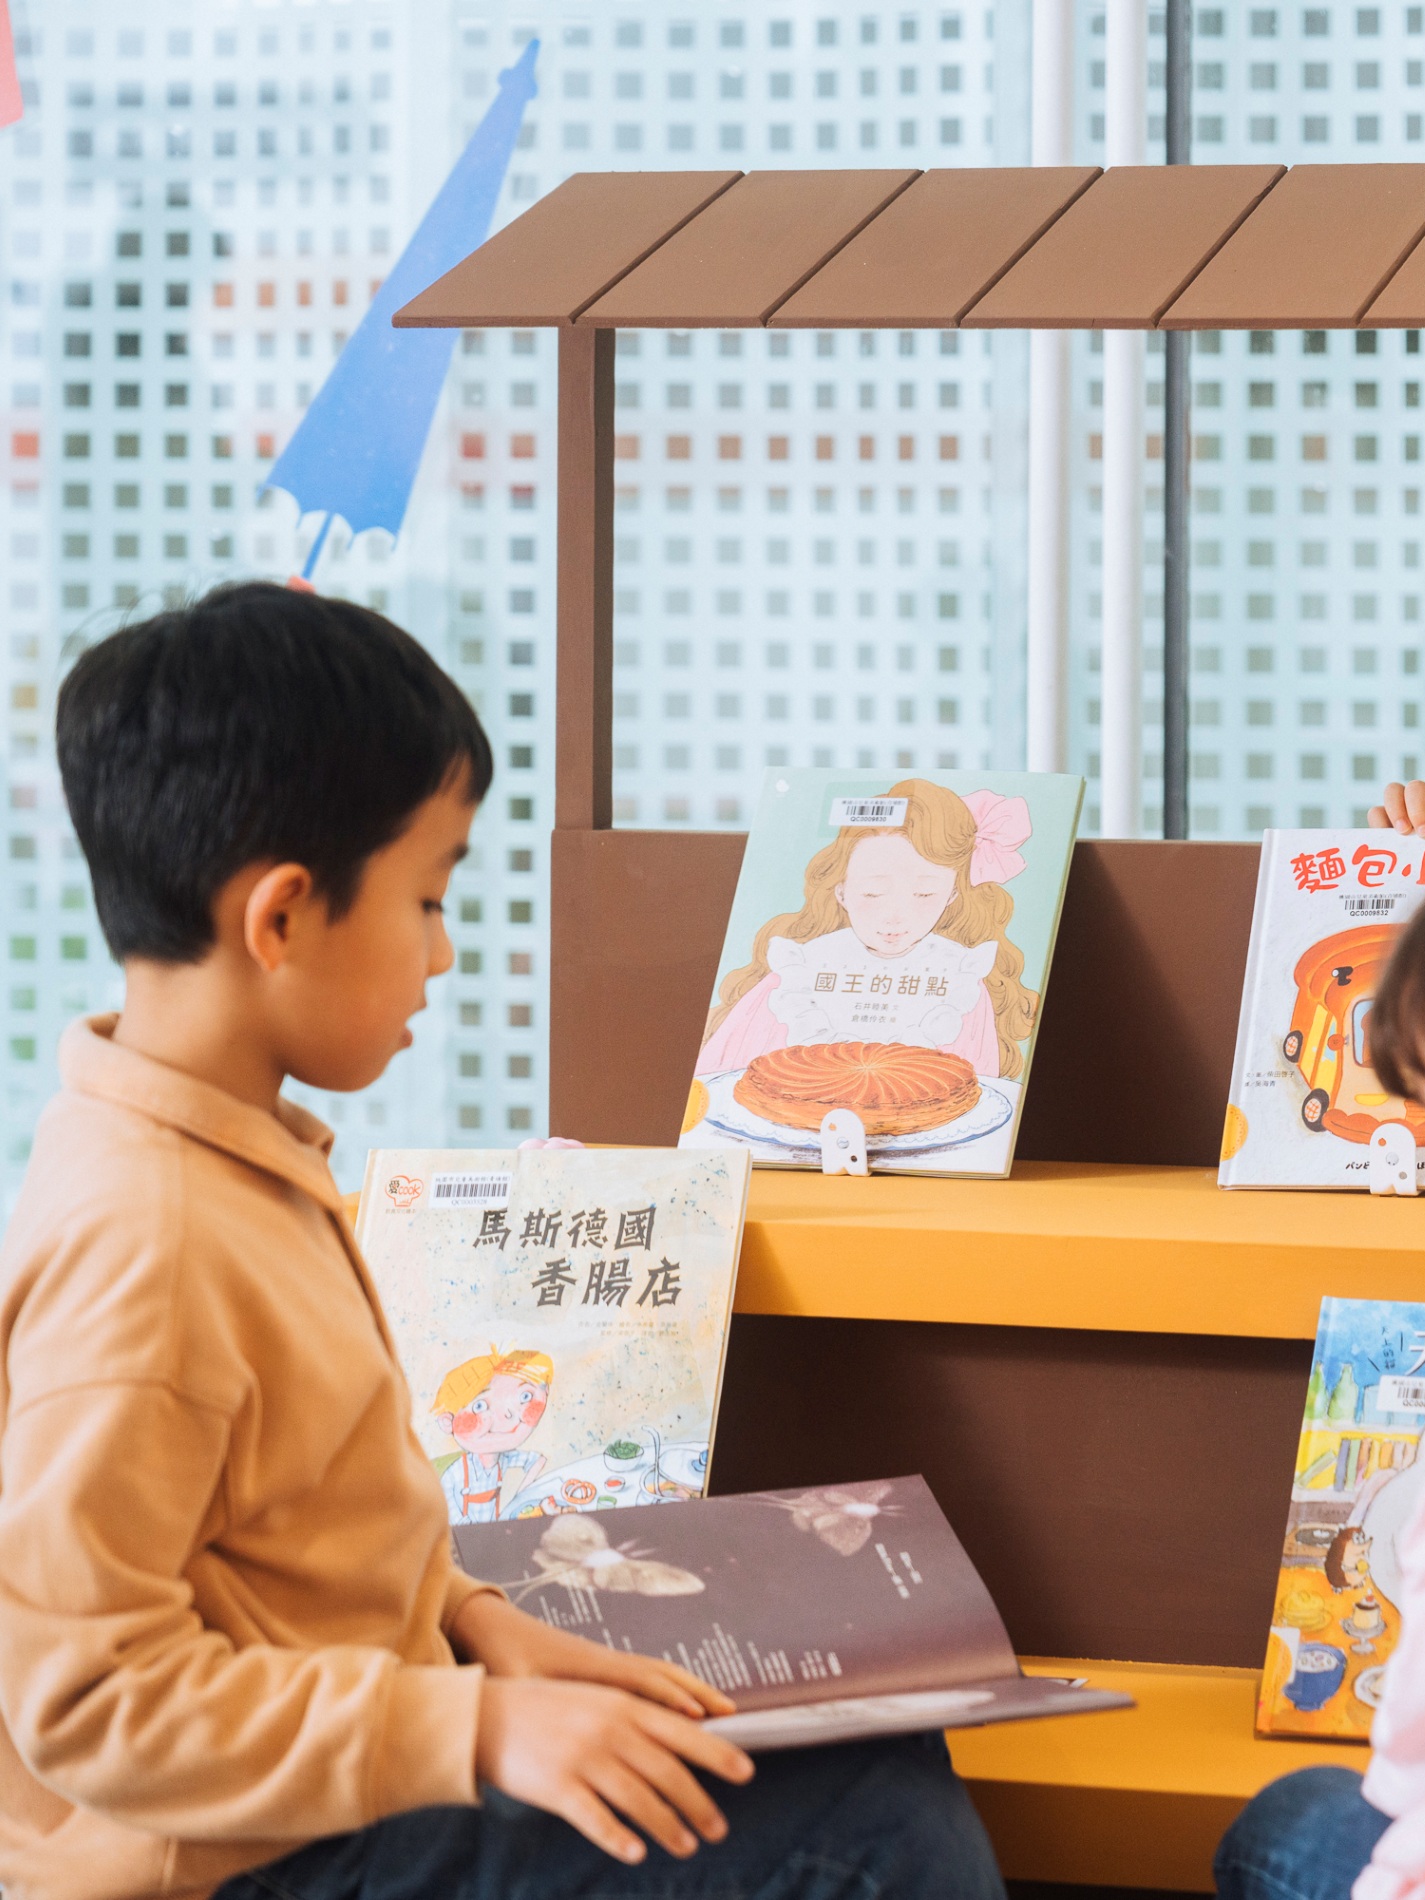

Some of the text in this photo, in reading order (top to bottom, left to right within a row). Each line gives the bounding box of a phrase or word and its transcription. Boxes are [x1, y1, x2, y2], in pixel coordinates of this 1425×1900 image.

[814, 972, 949, 996] 國王的甜點
[472, 1207, 657, 1251] 馬斯德國
[531, 1256, 683, 1308] 香腸店
